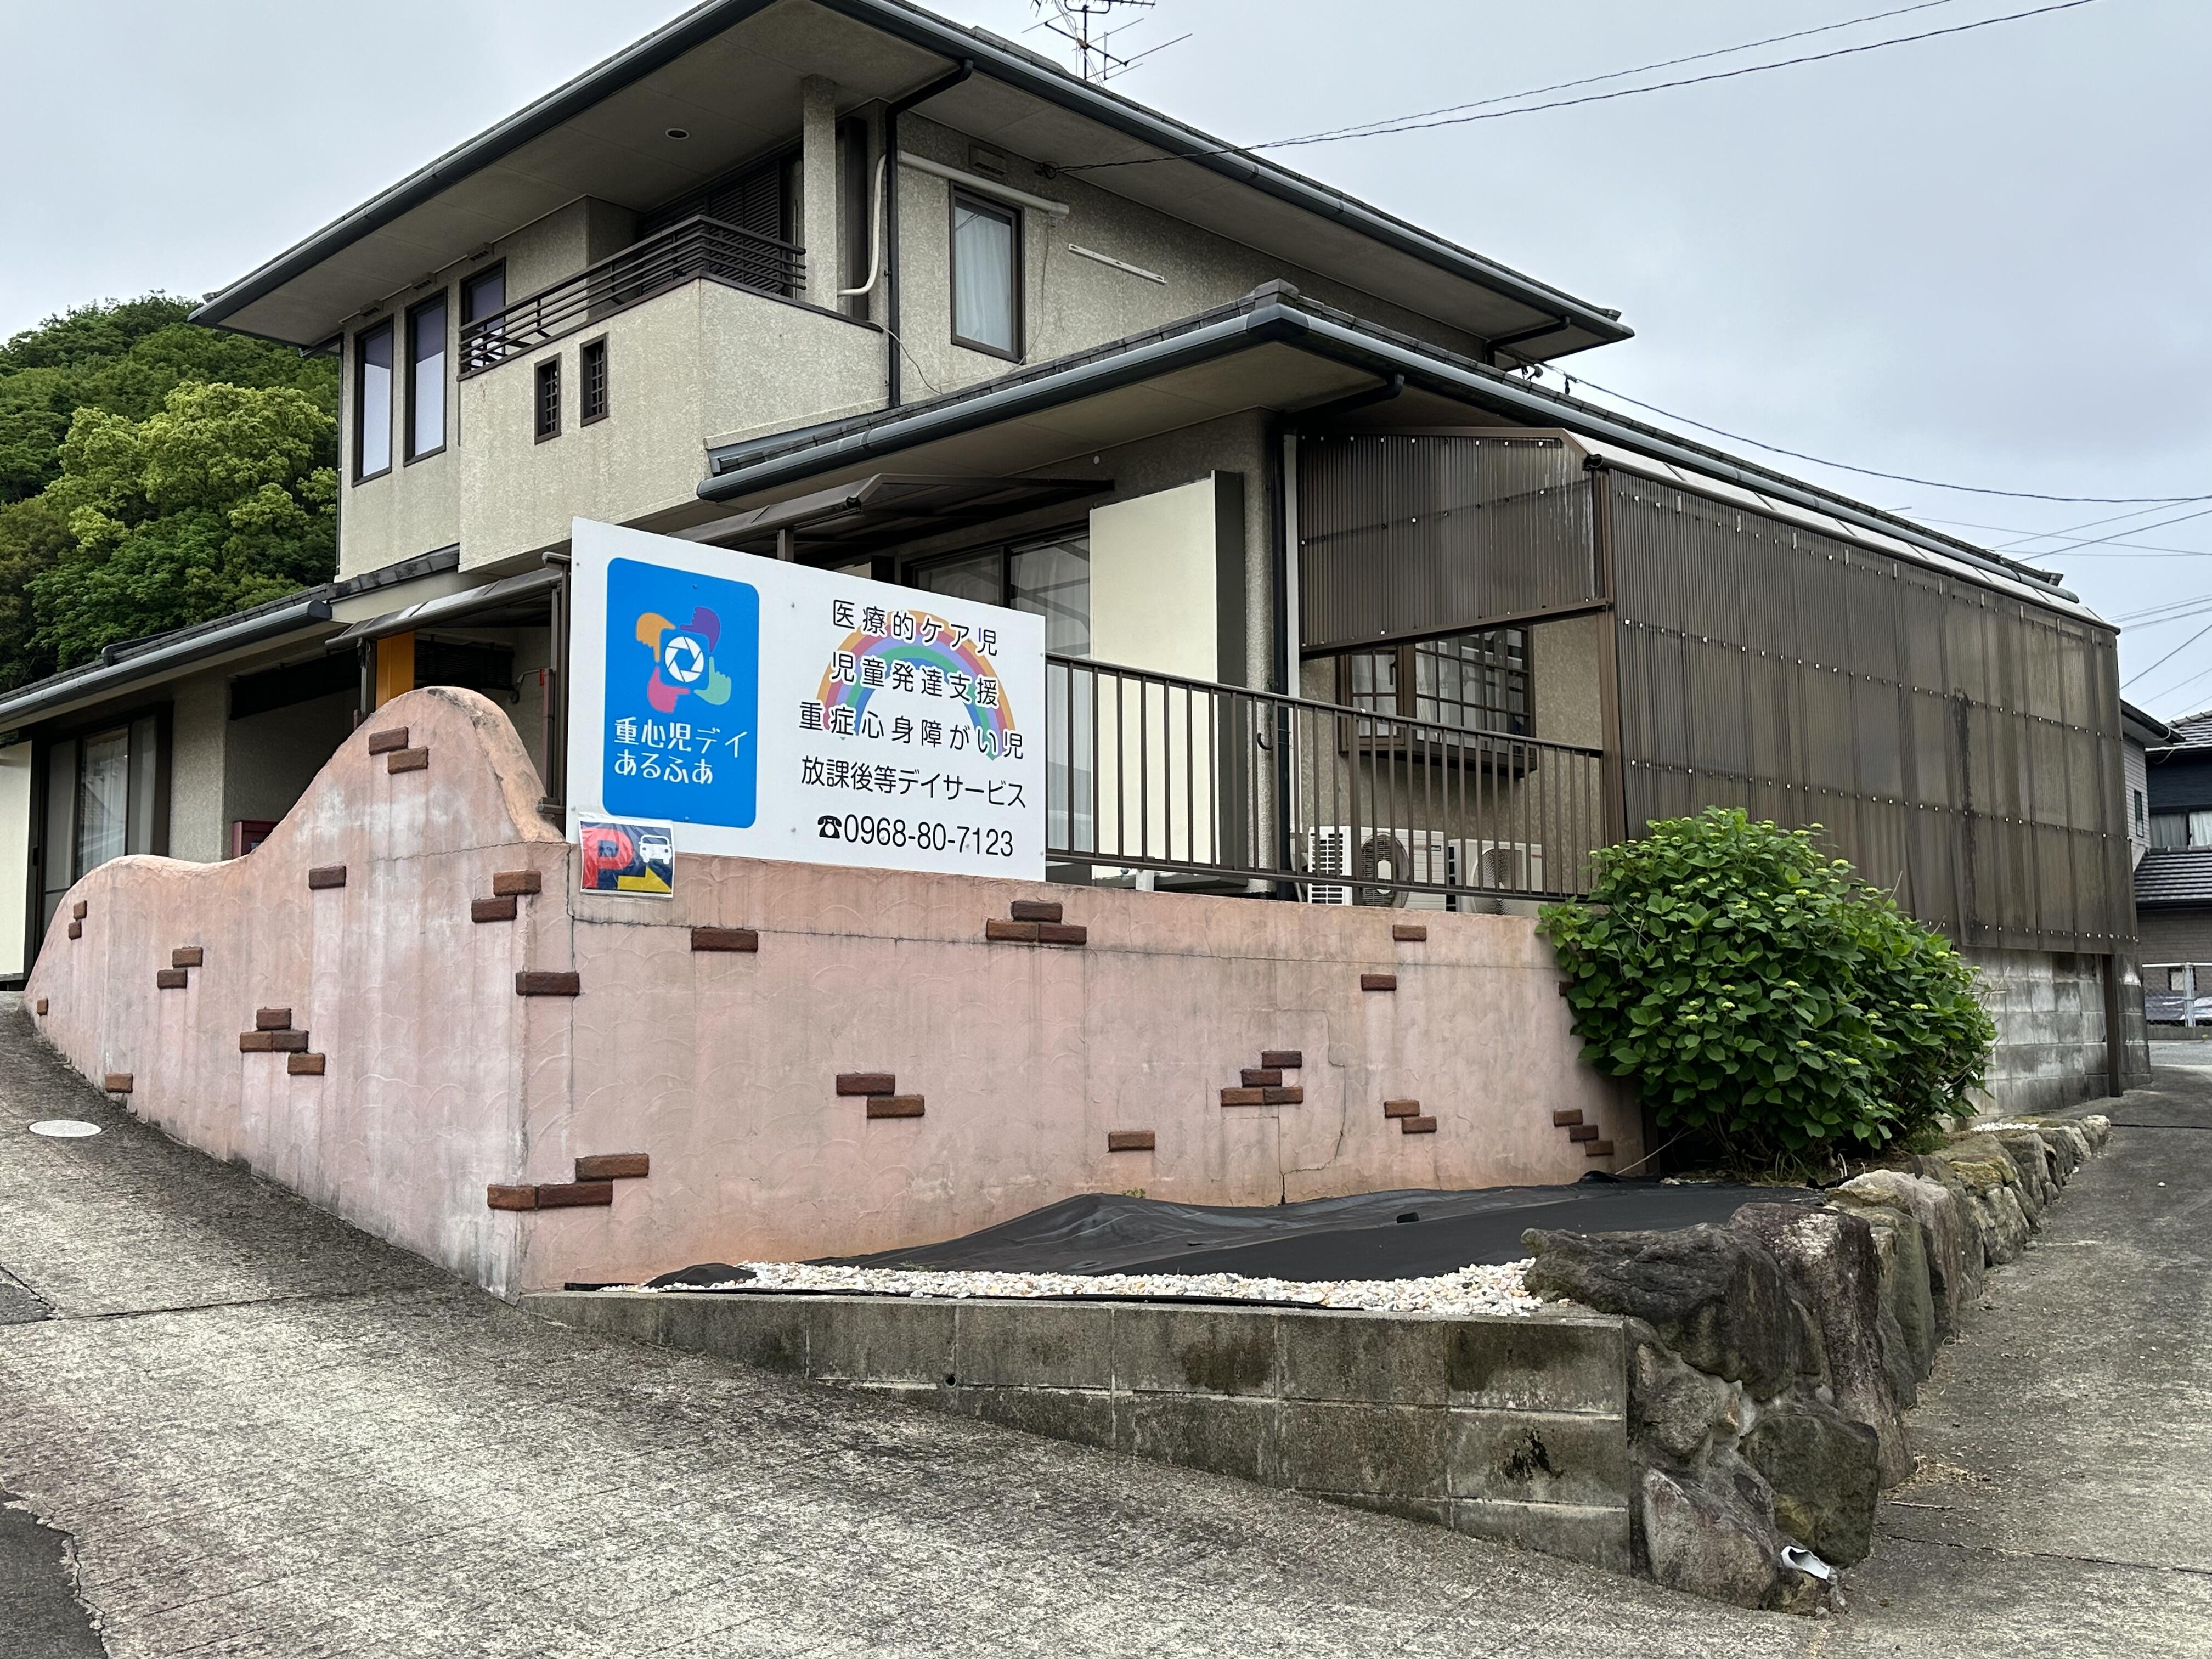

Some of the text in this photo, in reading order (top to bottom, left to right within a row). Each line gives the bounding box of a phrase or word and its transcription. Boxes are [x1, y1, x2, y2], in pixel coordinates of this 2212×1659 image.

[833, 599, 997, 656] 医療的ケア児
[831, 651, 998, 707] 児童発達支援
[614, 716, 748, 758] 重心児デイ
[798, 701, 1024, 759] 重症心身障がい児
[801, 755, 1026, 808] 放課後等デイサービス
[582, 828, 634, 888] P
[844, 814, 1013, 857] 0968-80-7123
